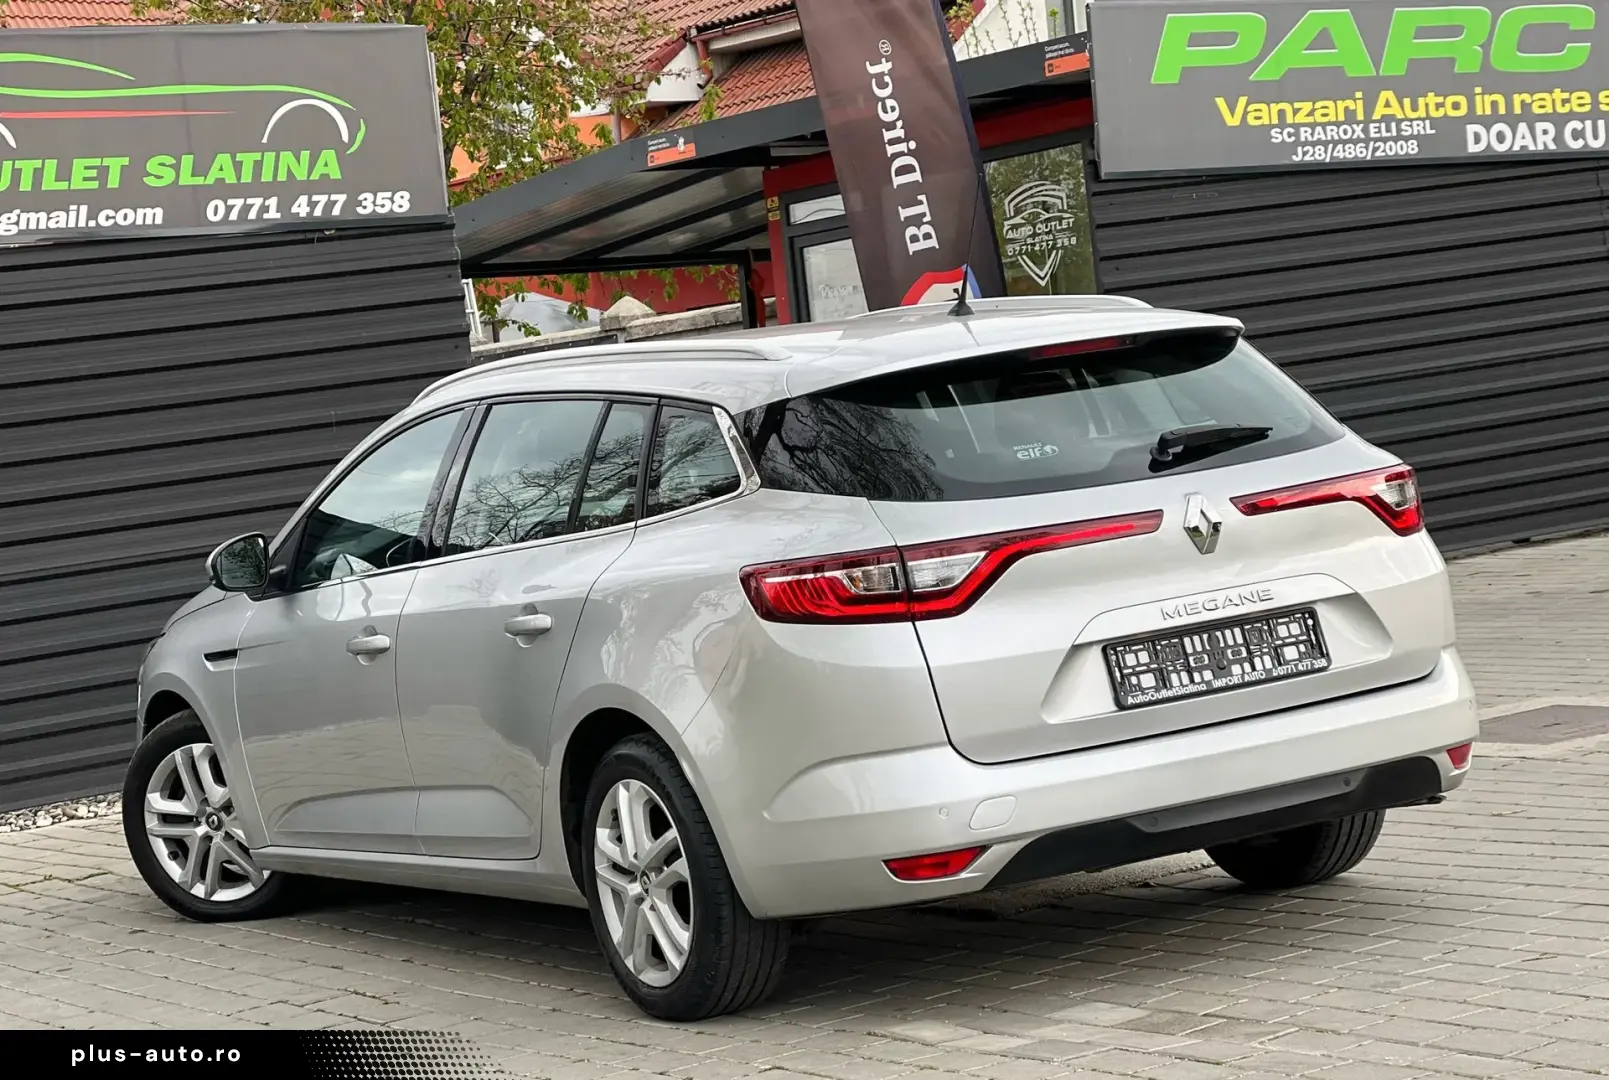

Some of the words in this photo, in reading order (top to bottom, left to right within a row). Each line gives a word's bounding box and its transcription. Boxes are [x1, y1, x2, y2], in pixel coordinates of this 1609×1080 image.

[1151, 4, 1595, 84] PARC
[1215, 91, 1363, 127] Vanzari
[1372, 89, 1467, 120] Auto
[1474, 87, 1506, 115] in
[1513, 87, 1592, 114] rate
[1270, 127, 1296, 143] SC
[1300, 123, 1366, 142] RAROX
[1369, 121, 1397, 138] ELI
[1401, 119, 1436, 136] SRL
[1466, 121, 1557, 153] DOAR
[1564, 119, 1606, 149] CU
[1291, 139, 1419, 162] J28/486/2008
[142, 149, 343, 187] SLATINA
[206, 196, 282, 222] 0771
[291, 193, 347, 217] 477
[355, 190, 411, 213] 358
[1006, 226, 1034, 239] AUTO
[1035, 218, 1075, 233] OUTLET
[1026, 233, 1054, 244] SLATINA
[1007, 244, 1031, 256] 0771
[1034, 240, 1053, 251] 477
[1056, 236, 1077, 247] 358
[1160, 588, 1274, 620] MEGANE
[1127, 682, 1207, 705] AutoOutletSlatina
[1211, 674, 1243, 688] IMPORT
[1244, 670, 1266, 682] AUTO
[1277, 664, 1297, 675] 0771
[1298, 661, 1312, 671] 477
[1312, 658, 1328, 669] 358
